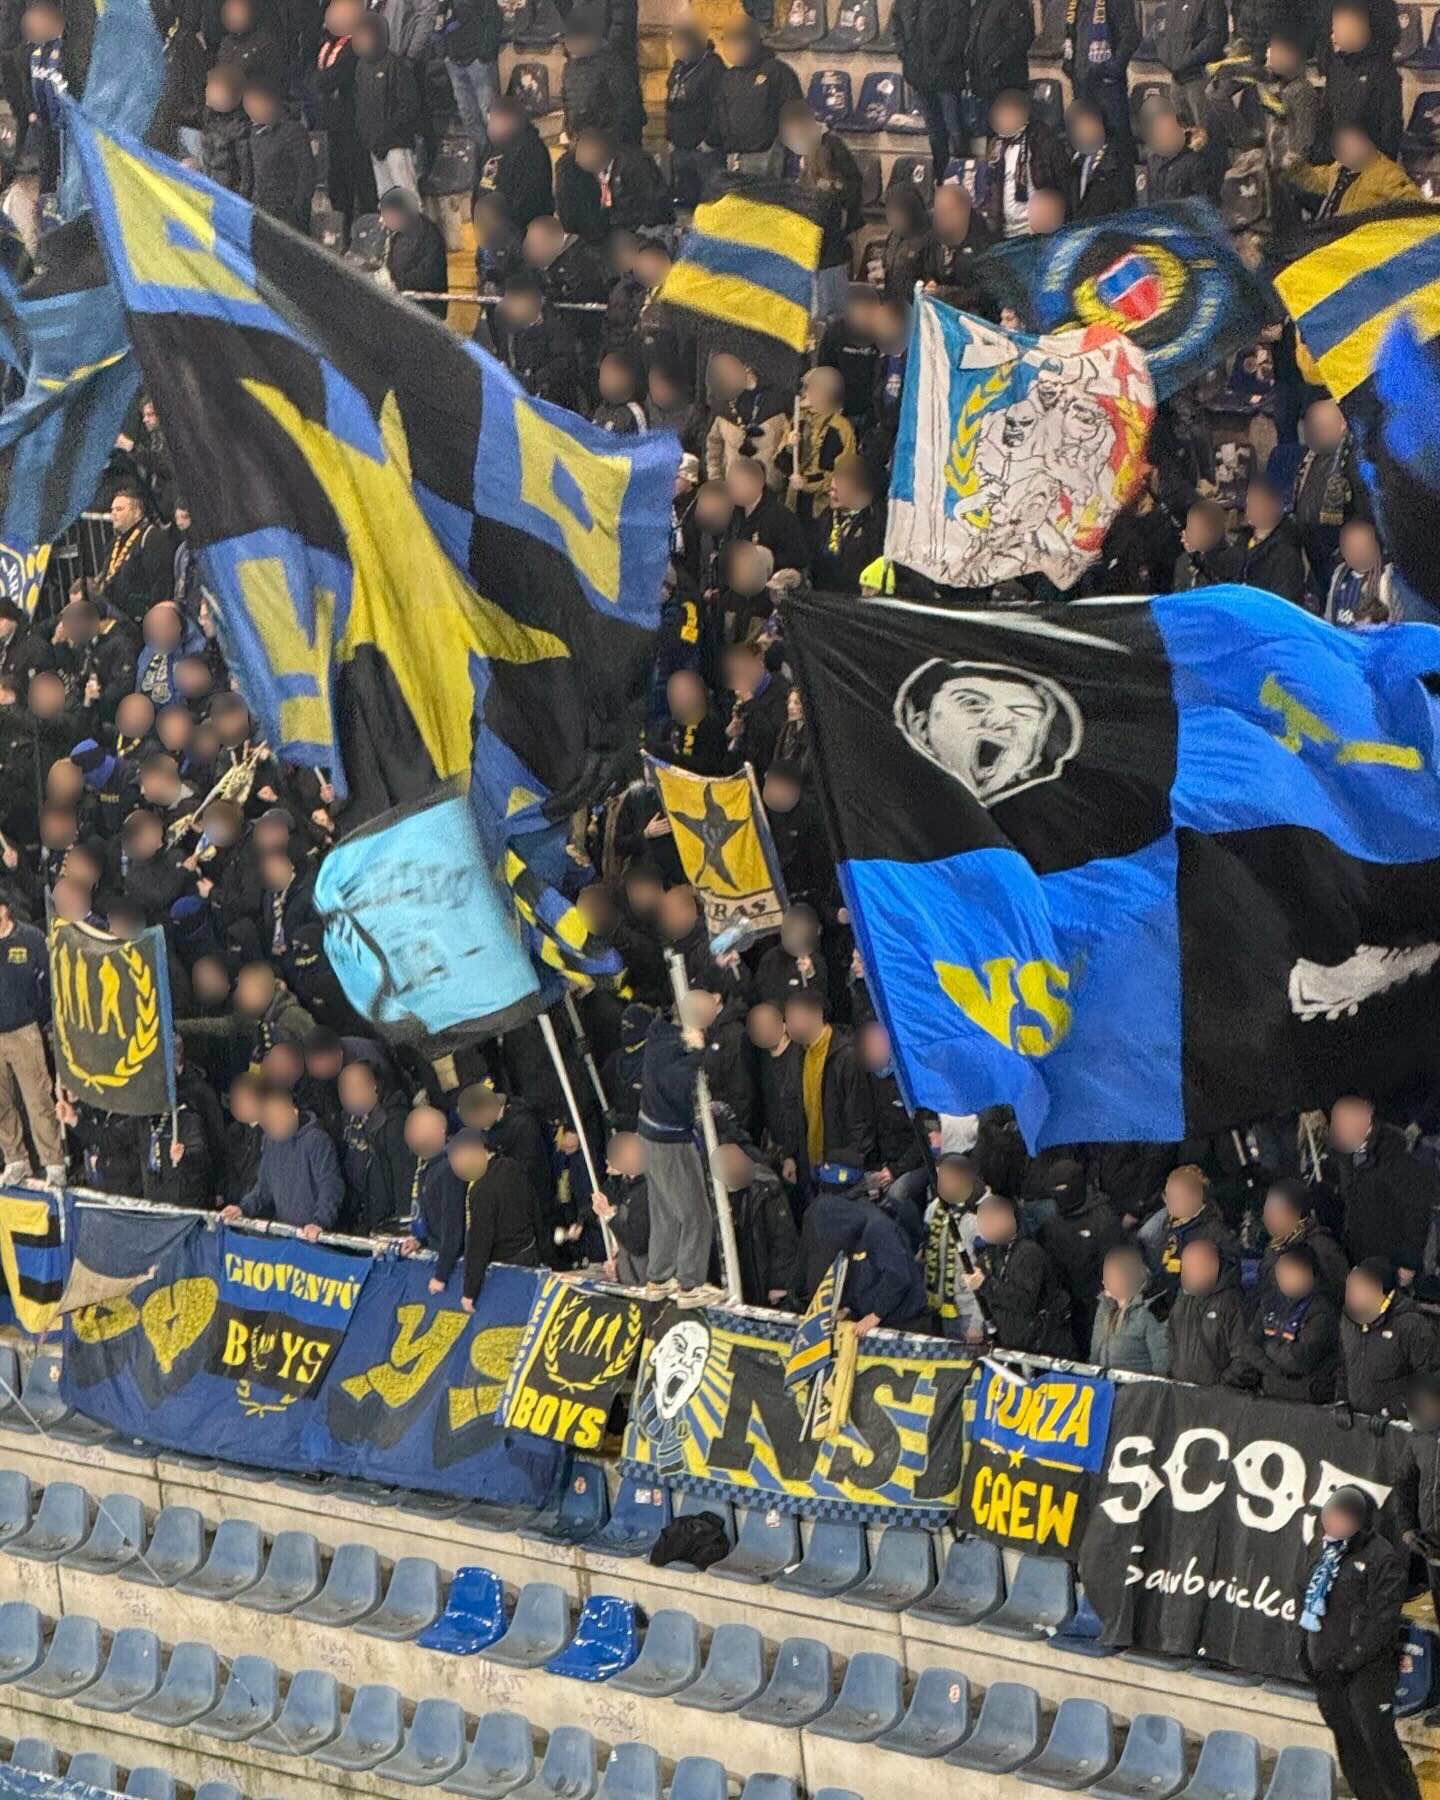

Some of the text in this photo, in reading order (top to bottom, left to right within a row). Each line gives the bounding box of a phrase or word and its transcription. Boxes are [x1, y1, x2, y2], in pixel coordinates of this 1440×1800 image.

[932, 956, 1072, 1057] VS
[511, 1386, 607, 1449] BOYS
[971, 1466, 1079, 1547] CREW
